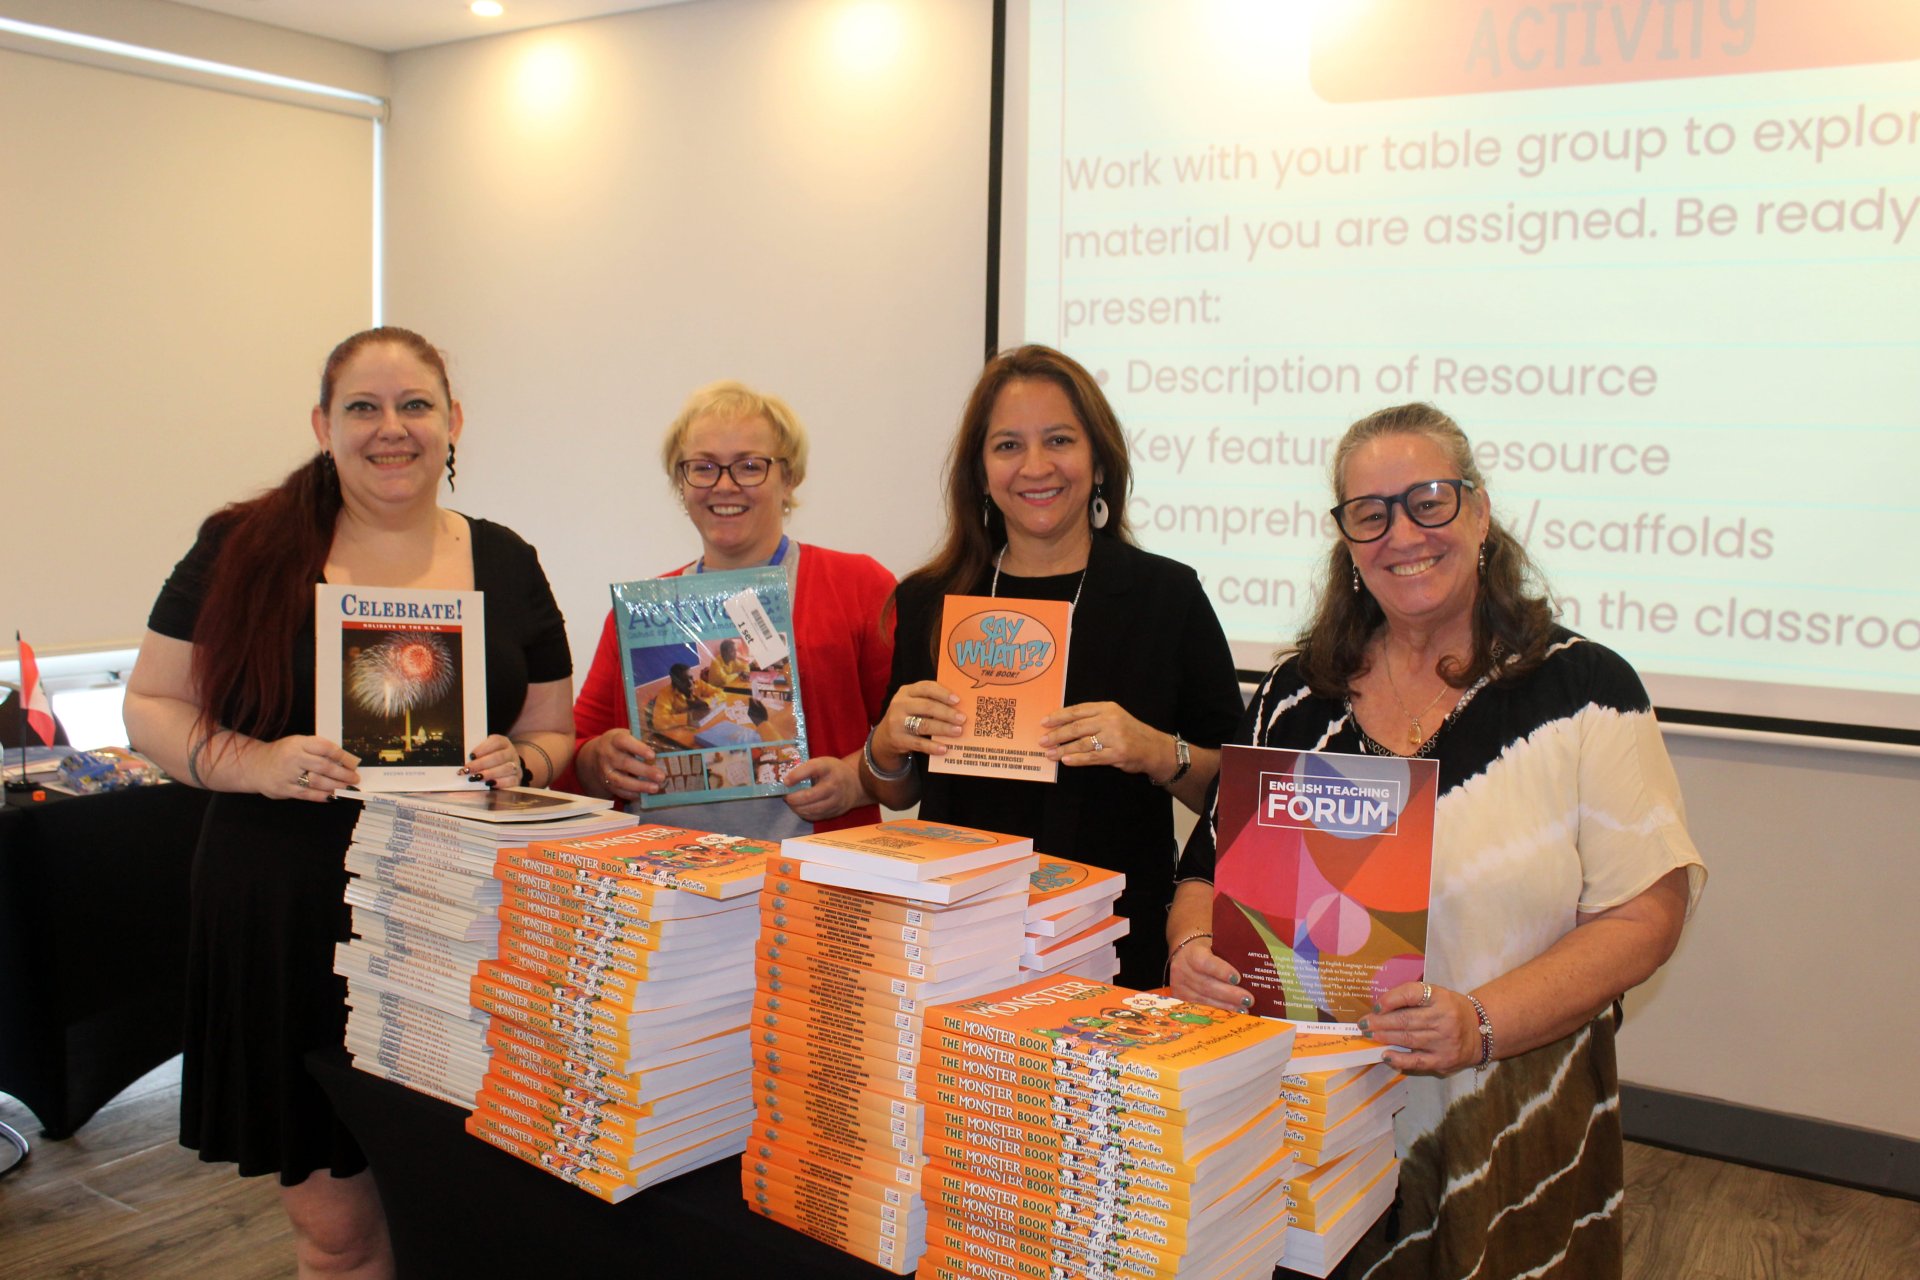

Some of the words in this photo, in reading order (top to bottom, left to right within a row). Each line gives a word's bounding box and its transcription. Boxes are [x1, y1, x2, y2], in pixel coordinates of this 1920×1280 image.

[1066, 150, 1161, 190] Work
[1173, 144, 1257, 182] with
[1271, 144, 1368, 190] your
[1382, 129, 1501, 171] table
[1517, 125, 1667, 178] group
[1684, 117, 1736, 156] to
[1065, 215, 1230, 259] material
[1243, 220, 1320, 262] you
[1335, 216, 1409, 247] are
[1424, 197, 1657, 255] assigned.
[1675, 197, 1738, 237] Be
[1756, 187, 1920, 245] ready
[1063, 289, 1221, 338] present:
[1127, 356, 1360, 405] Description
[1375, 354, 1419, 393] of
[1433, 357, 1658, 396] Resource
[1127, 428, 1196, 474] Key
[1207, 427, 1337, 466] featur
[1473, 440, 1670, 476] esource
[1126, 496, 1338, 545] Comprehe
[341, 594, 462, 620] CELEBRATE!
[1218, 575, 1295, 608] can
[1598, 591, 1678, 633] the
[742, 629, 754, 644] set
[980, 616, 1024, 643] SAY
[955, 639, 1051, 671] WHAT!?!
[980, 669, 993, 677] THE
[995, 670, 1020, 678] BOOK!
[1268, 793, 1388, 827] FORUM
[1269, 780, 1322, 794] ENGLISH
[1325, 785, 1390, 798] TEACHING
[543, 850, 556, 859] THE
[559, 852, 599, 870] MONSTER
[601, 862, 623, 874] BOOK
[964, 981, 1107, 1018] MONSTER
[498, 1040, 508, 1050] THE
[510, 1044, 541, 1063] MONSTER
[543, 1058, 560, 1069] BOOK
[942, 1037, 959, 1050] THE
[962, 1041, 1016, 1067] MONSTER
[1019, 1057, 1047, 1072] BOOK
[1061, 1067, 1093, 1085] Language
[1127, 1084, 1159, 1099] Activities
[943, 1017, 961, 1030] THE
[964, 1020, 1017, 1047] MONSTER
[1019, 1036, 1048, 1052] BOOK
[1061, 1047, 1093, 1063] Language
[1126, 1063, 1158, 1078] Activities
[937, 1073, 955, 1086] THE
[959, 1077, 1014, 1103] MONSTER
[1017, 1093, 1046, 1108] BOOK
[1060, 1103, 1094, 1120] Language
[1127, 1120, 1161, 1135] Activities
[941, 1056, 959, 1068] THE
[962, 1060, 1018, 1085] MONSTER
[1021, 1075, 1051, 1091] BOOK
[1065, 1087, 1098, 1103] Language
[1133, 1102, 1166, 1117] Activities
[1280, 1090, 1309, 1104] Activities
[937, 1091, 955, 1104] THE
[959, 1095, 1014, 1120] MONSTER
[1018, 1111, 1047, 1127] BOOK
[1061, 1123, 1094, 1140] Language
[1129, 1139, 1162, 1153] Activities
[1286, 1110, 1306, 1122] tivities
[945, 1113, 964, 1125] THE
[967, 1116, 1024, 1142] MONSTER
[1027, 1132, 1057, 1147] BOOK
[1072, 1143, 1106, 1159] Language
[1141, 1159, 1174, 1174] Activities
[943, 1177, 961, 1190] THE
[964, 1181, 1019, 1208] MONSTER
[1023, 1199, 1052, 1215] BOOK
